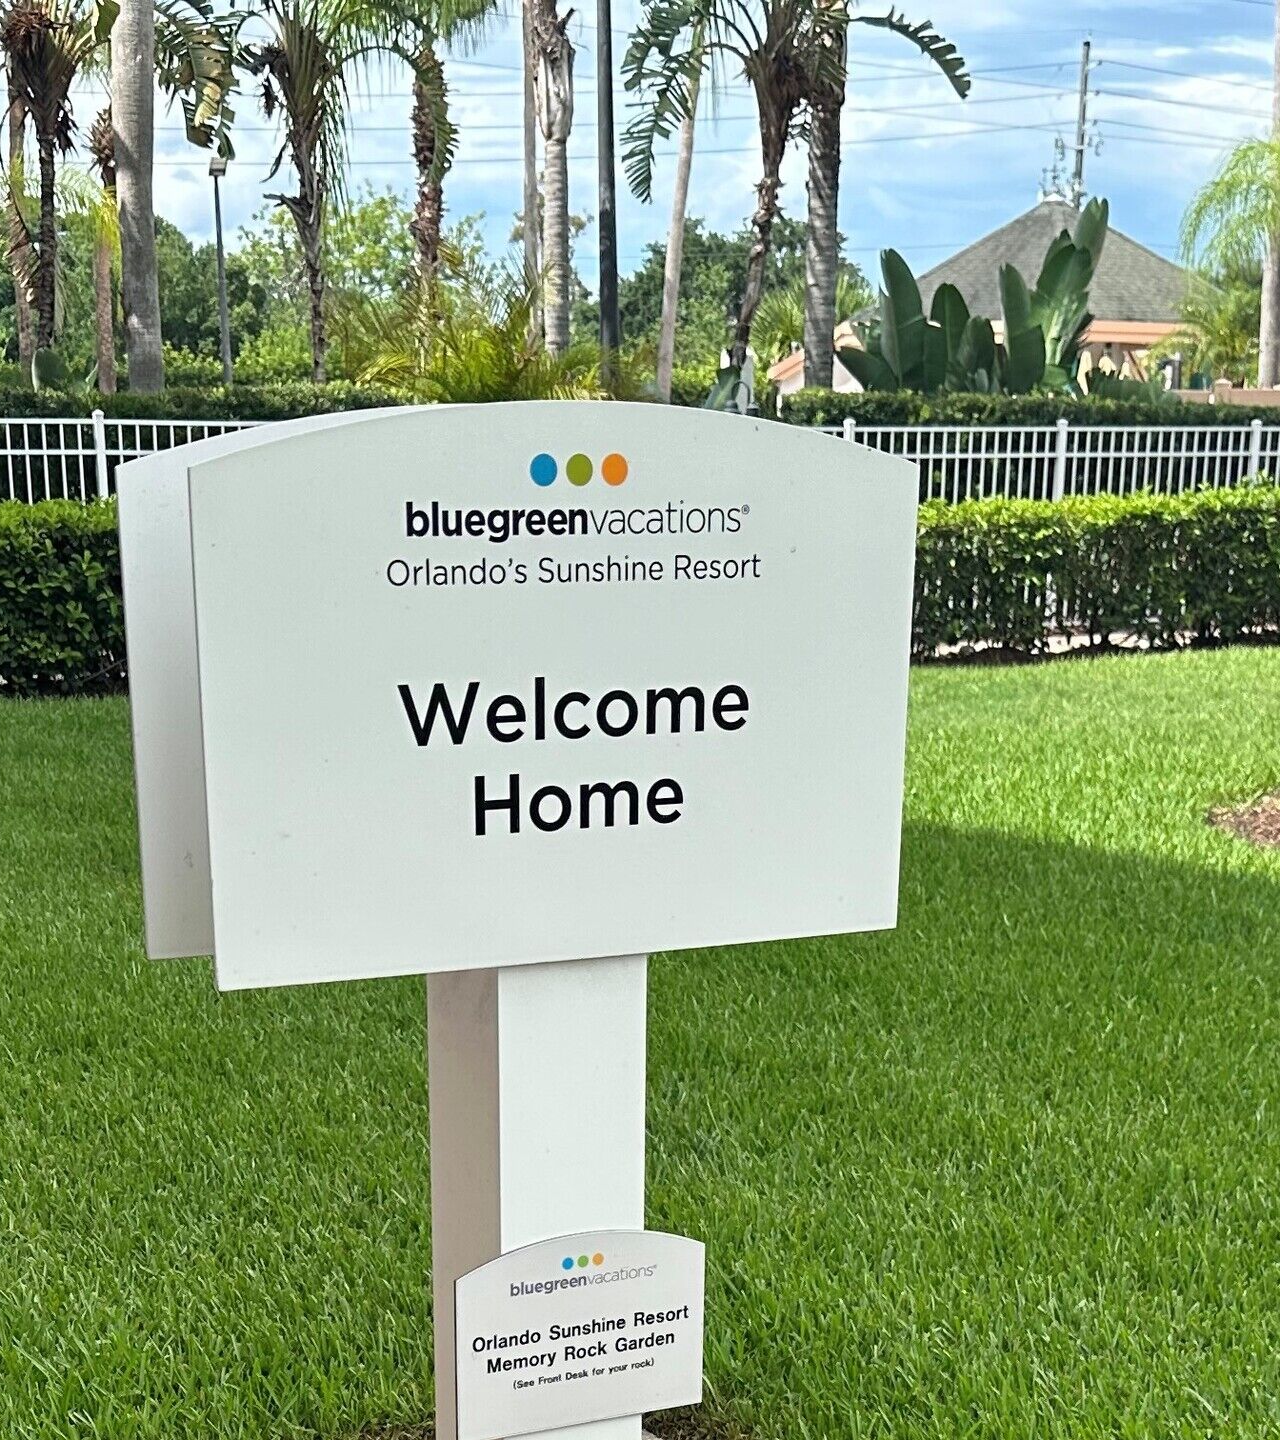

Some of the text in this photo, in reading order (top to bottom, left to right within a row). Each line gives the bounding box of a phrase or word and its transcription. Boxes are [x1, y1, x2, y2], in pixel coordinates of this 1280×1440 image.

[386, 552, 761, 587] Orlando’s Sunshine Resort
[397, 676, 749, 747] Welcome
[474, 773, 684, 836] Home
[472, 1305, 689, 1353] Orlando Sunshine Resort
[486, 1331, 675, 1375] Memory Rock Garden
[538, 1374, 562, 1386] Front
[565, 1370, 589, 1381] Desk
[592, 1366, 605, 1377] for
[608, 1364, 629, 1376] your
[631, 1357, 655, 1370] rock)
